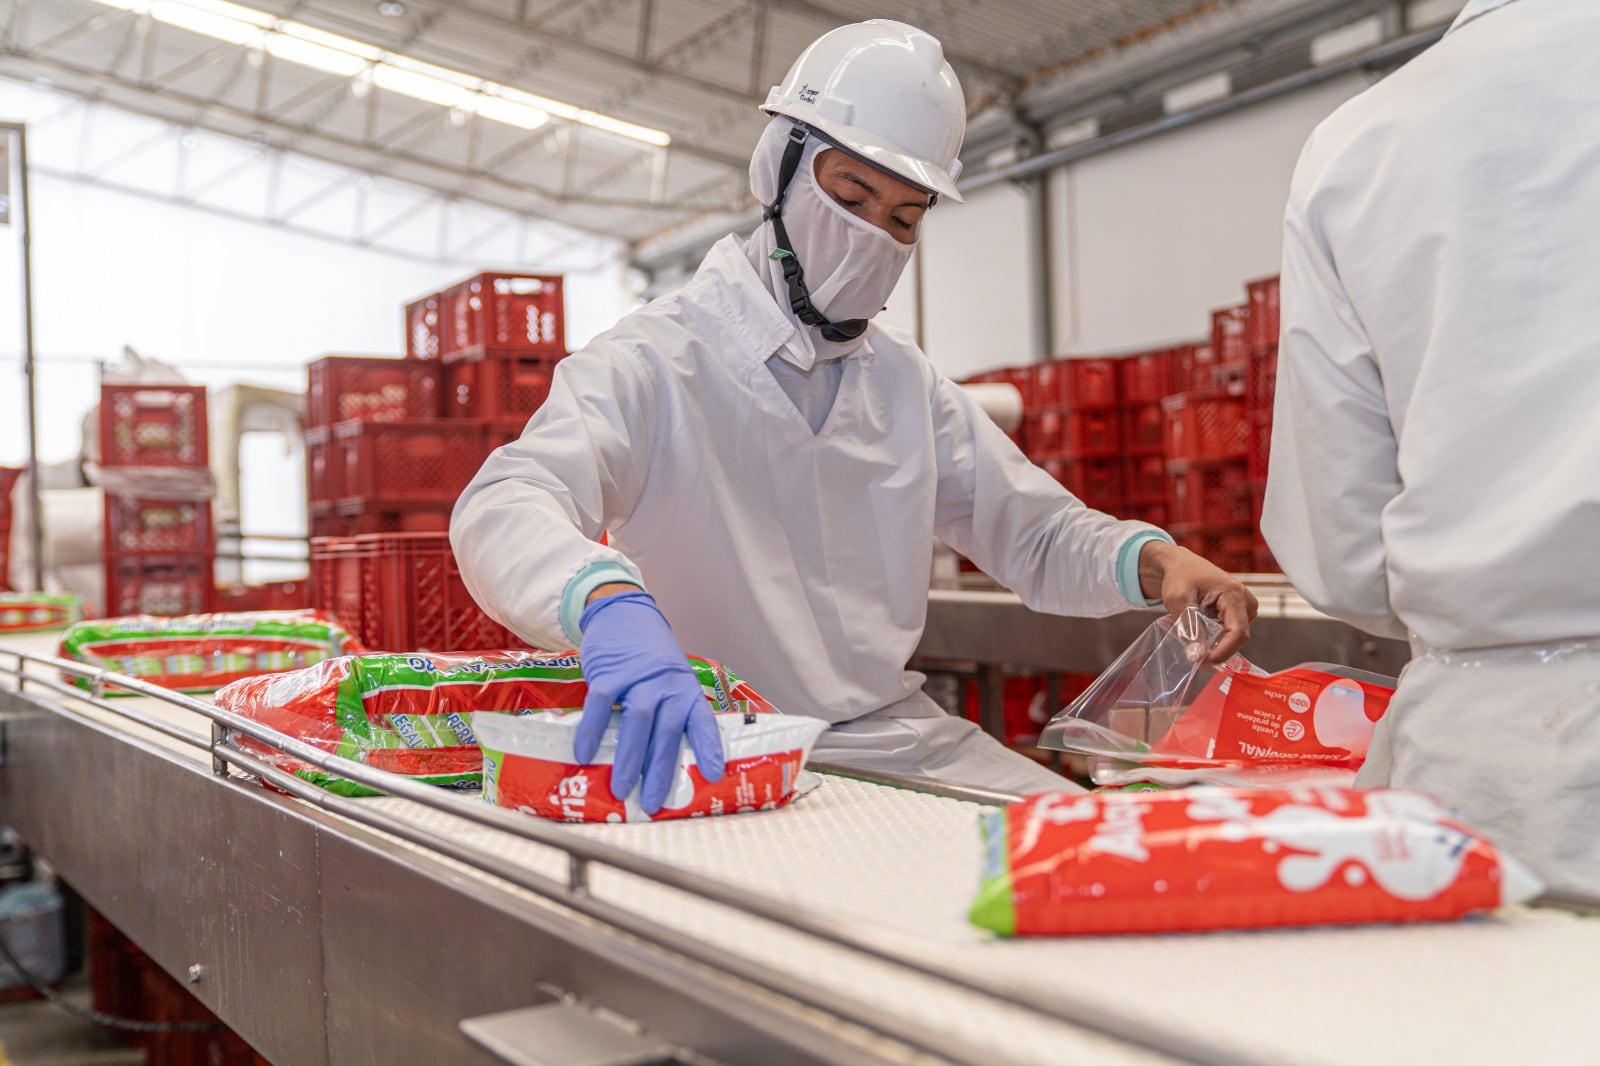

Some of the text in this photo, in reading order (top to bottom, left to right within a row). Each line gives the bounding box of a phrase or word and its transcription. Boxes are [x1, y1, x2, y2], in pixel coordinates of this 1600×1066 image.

[1264, 689, 1287, 702] Leche
[1254, 709, 1276, 720] calcio
[1252, 724, 1279, 738] Fuente
[1270, 722, 1280, 730] de
